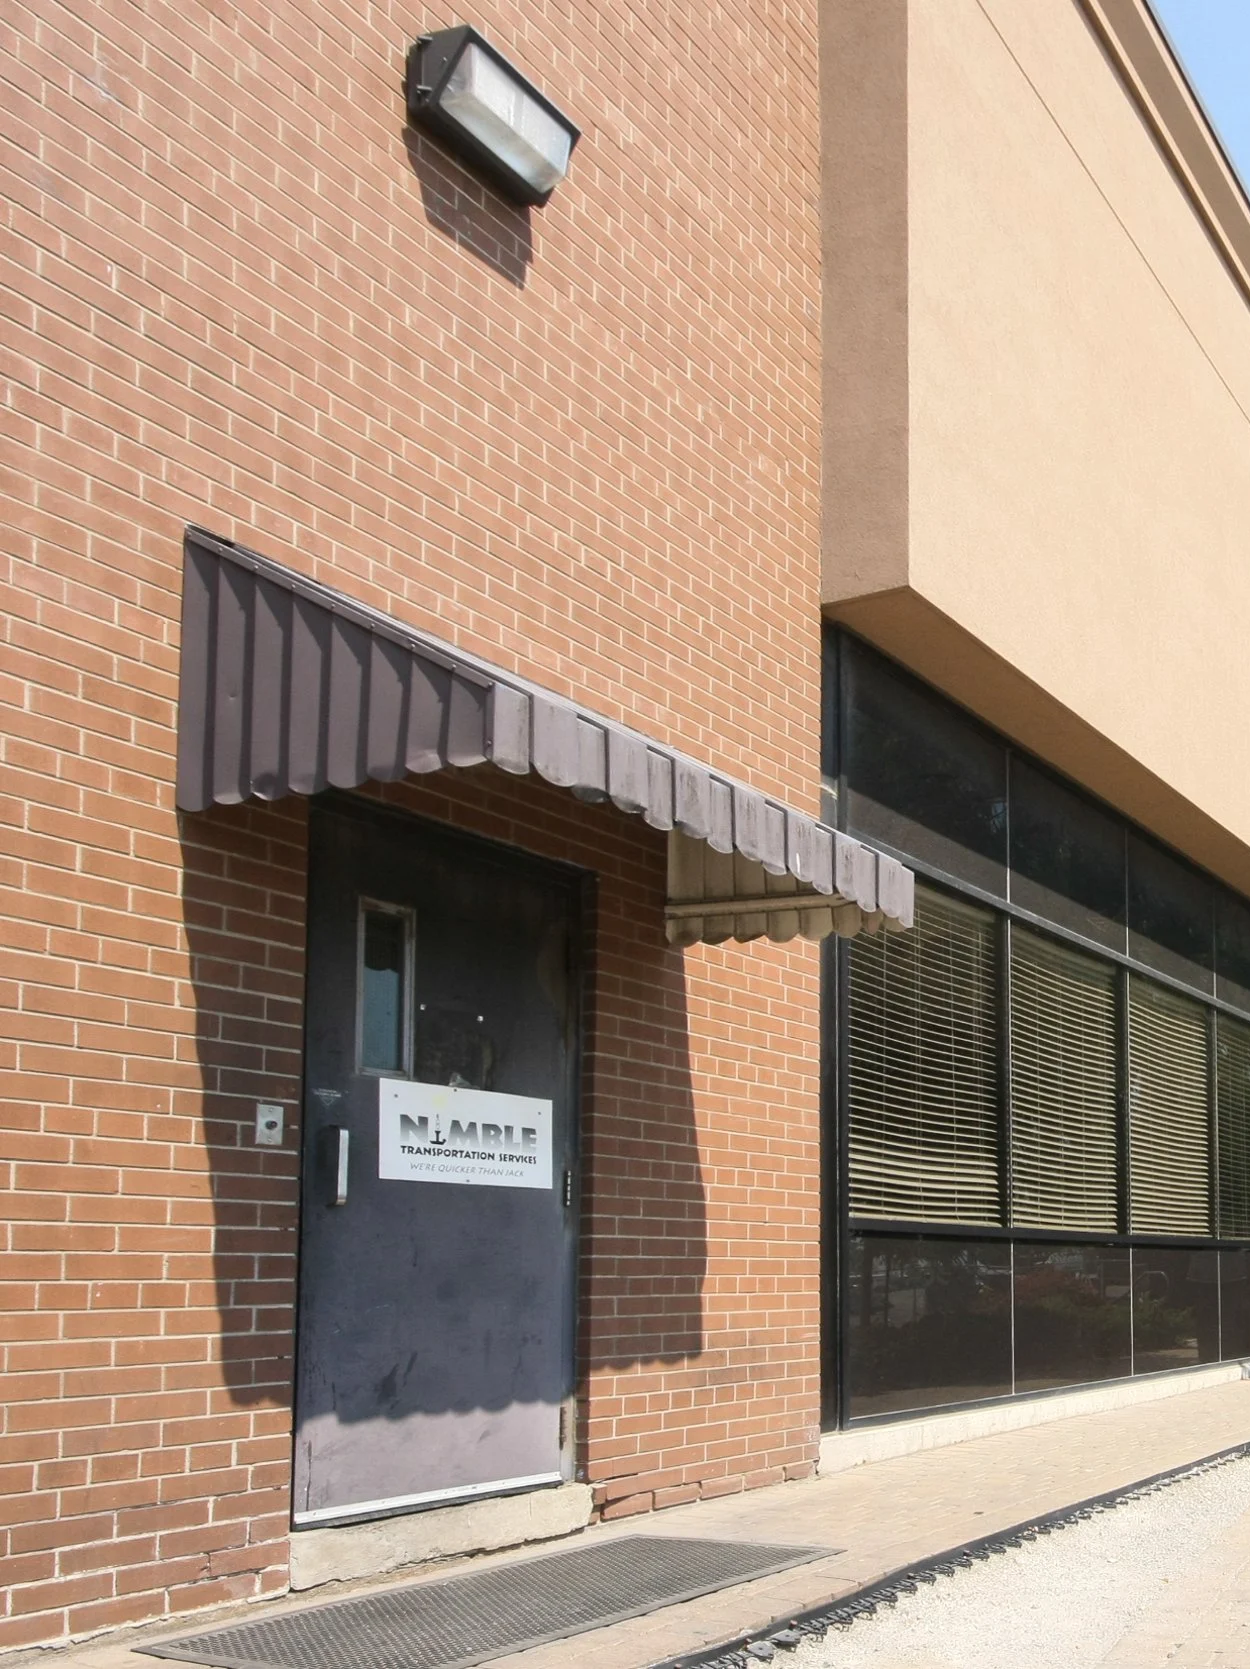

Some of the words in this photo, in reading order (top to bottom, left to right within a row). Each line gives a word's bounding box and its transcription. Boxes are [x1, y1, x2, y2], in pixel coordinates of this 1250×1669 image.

[400, 1145, 495, 1161] TRANSPORTATION
[499, 1153, 537, 1165] SERVICES
[438, 1163, 476, 1174] QUICKER
[478, 1167, 503, 1176] THAN
[504, 1169, 525, 1177] JACK
